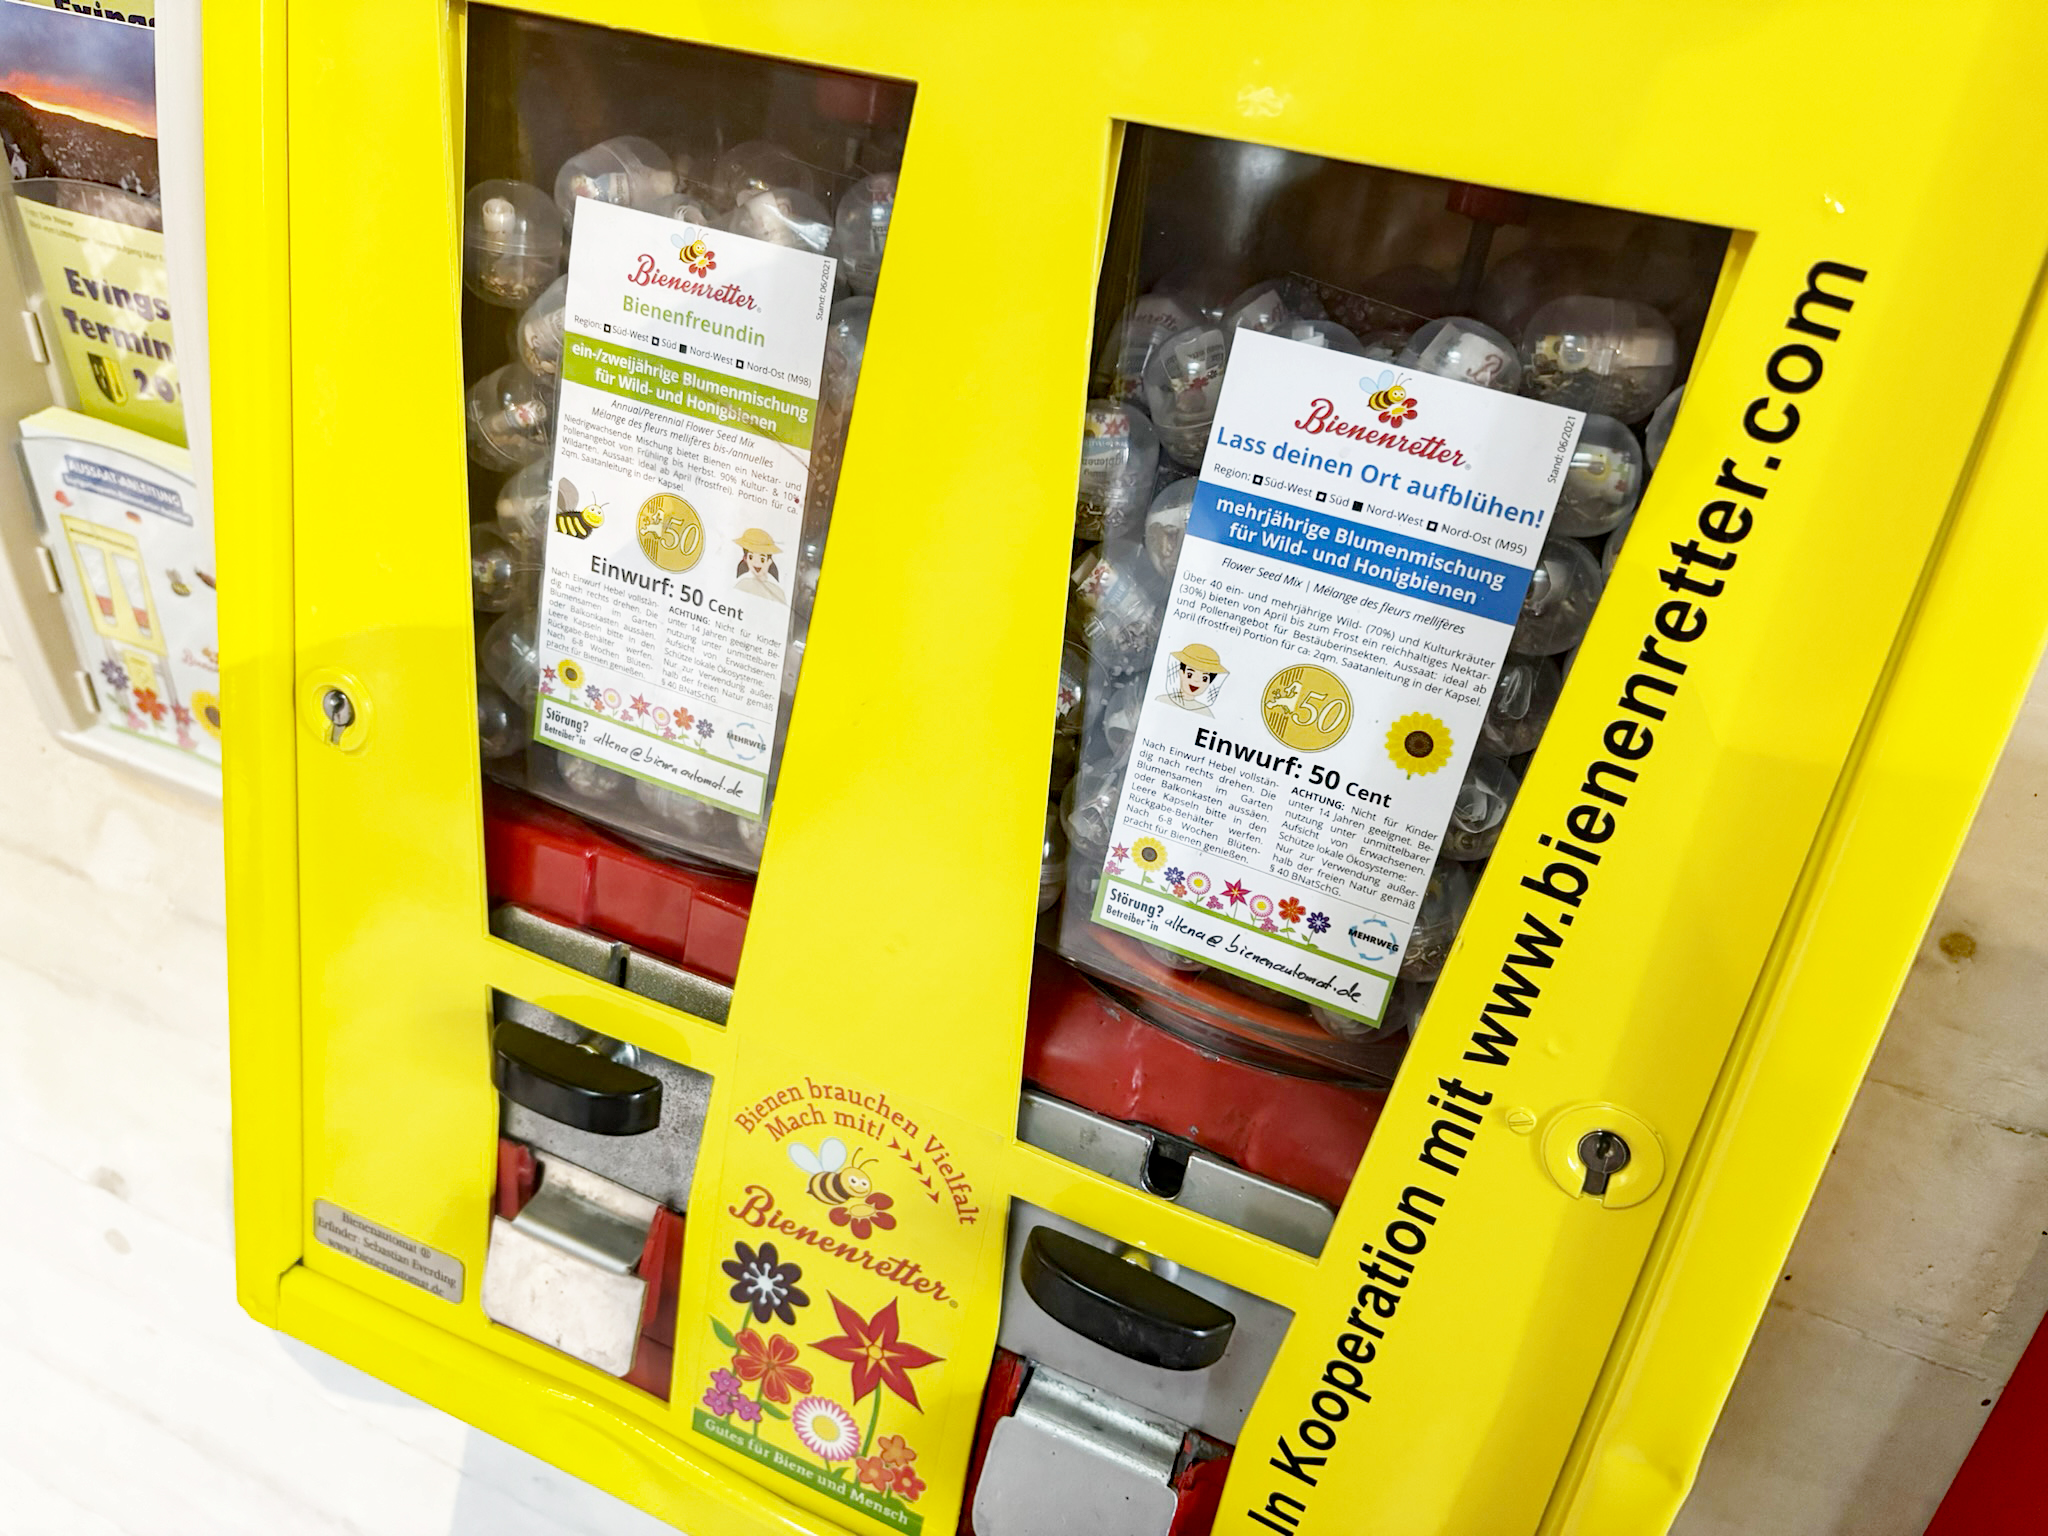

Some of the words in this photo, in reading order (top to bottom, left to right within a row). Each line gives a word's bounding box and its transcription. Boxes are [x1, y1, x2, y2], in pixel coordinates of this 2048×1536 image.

[627, 253, 757, 311] Bienenretter
[815, 294, 827, 321] Stand:
[821, 259, 832, 293] 06/2021
[574, 314, 602, 331] Region:
[611, 323, 650, 344] Süd-West
[661, 338, 678, 350] Süd
[689, 345, 734, 366] Nord-West
[746, 361, 785, 380] Nord-Ost
[787, 373, 812, 389] (M98)
[623, 294, 765, 348] Bienenfreundin
[572, 342, 679, 385] ein-/zweijährige
[682, 371, 809, 424] Blumenmischung
[595, 367, 616, 385] für
[618, 374, 654, 396] Wild-
[656, 387, 684, 405] und
[686, 393, 777, 432] Honigbienen
[591, 406, 626, 426] Mélange
[627, 417, 643, 430] des
[642, 421, 668, 437] fleurs
[669, 431, 711, 450] mellifères
[712, 442, 774, 469] bis-/annuelles
[610, 399, 685, 428] Annual/Perennial
[685, 420, 715, 436] Flower
[716, 429, 738, 443] Seed
[738, 436, 755, 449] Mix
[1294, 398, 1468, 467] Bienenretter
[1547, 451, 1564, 485] Stand:
[1557, 415, 1577, 453] 06/2021
[1213, 462, 1251, 482] Region:
[1263, 476, 1313, 498] Süd-West
[1328, 493, 1351, 508] Süd
[1366, 503, 1424, 528] Nord-West
[1440, 523, 1492, 546] Nord-Ost
[1494, 538, 1528, 557] (M95)
[1216, 426, 1267, 456] Lass
[1272, 441, 1353, 479] deinen
[1360, 464, 1402, 491] Ort
[1406, 479, 1545, 529] aufblühen!
[660, 518, 700, 557] 50
[1216, 498, 1331, 541] mehrjährige
[1334, 527, 1507, 592] Blumenmischung
[1228, 521, 1259, 543] für
[1261, 530, 1309, 557] Wild-
[1312, 548, 1351, 569] und
[1353, 556, 1477, 605] Honigbienen
[590, 554, 675, 599] Einwurf:
[679, 583, 704, 607] 50
[708, 598, 744, 621] Cent
[1182, 571, 1207, 585] Über
[1209, 579, 1223, 591] 40
[1225, 584, 1245, 596] ein-
[1247, 591, 1269, 604] und
[1270, 598, 1333, 623] mehrjährige
[1336, 615, 1362, 630] Wild-
[1365, 623, 1396, 642] (70%)
[1398, 635, 1421, 648] und
[1423, 640, 1497, 669] Kulturkräuter
[1221, 557, 1257, 575] Flower
[1256, 567, 1284, 583] Seed
[1282, 574, 1304, 588] Mix
[1312, 582, 1359, 605] Mélange
[1359, 596, 1379, 610] des
[1377, 601, 1412, 620] fleurs
[1412, 613, 1466, 635] mellifères
[1172, 608, 1197, 622] April
[1196, 614, 1245, 637] (frostfrei)
[1242, 627, 1279, 647] Portion
[1280, 638, 1296, 651] für
[1312, 648, 1338, 665] 2qm.
[1340, 657, 1411, 688] Saatanleitung
[1411, 678, 1423, 689] in
[1424, 682, 1444, 695] der
[1444, 687, 1481, 707] Kapsel.
[1176, 597, 1197, 609] und
[1199, 602, 1270, 631] Pollenangebot
[1273, 623, 1289, 636] für
[1292, 629, 1388, 666] Bestäuberinsekten.
[1392, 659, 1438, 680] Aussaat:
[1442, 673, 1469, 689] ideal
[1472, 683, 1487, 695] ab
[1179, 583, 1207, 601] (30%)
[1208, 591, 1240, 609] bieten
[1242, 603, 1261, 615] von
[1262, 608, 1289, 623] April
[1289, 614, 1305, 628] bis
[1307, 622, 1330, 635] zum
[1332, 627, 1360, 644] Frost
[1361, 637, 1378, 649] ein
[1380, 643, 1449, 669] reichhaltiges
[1450, 662, 1491, 681] Nektar-
[1462, 258, 1870, 1068] www.bienenretter.com
[546, 707, 589, 733] Störung?
[726, 731, 767, 751] MEHRWEG
[1292, 691, 1348, 734] 50
[1136, 759, 1203, 788] Blumensamen
[1215, 785, 1228, 797] im
[1240, 794, 1274, 812] Garten
[1139, 749, 1154, 763] dig
[1157, 756, 1181, 769] nach
[1184, 765, 1214, 780] rechts
[1218, 774, 1255, 794] drehen.
[1260, 787, 1277, 801] Die
[1142, 737, 1166, 752] Nach
[1169, 746, 1206, 765] Einwurf
[1207, 758, 1237, 775] Hebel
[1239, 770, 1279, 788] vollstän-
[1194, 727, 1303, 779] Einwurf:
[1308, 764, 1341, 791] 50
[1345, 781, 1393, 809] Cent
[1133, 772, 1156, 784] oder
[1160, 779, 1223, 807] Balkonkasten
[1227, 803, 1270, 823] aussäen.
[1290, 786, 1346, 811] ACHTUNG:
[1350, 805, 1377, 822] Nicht
[1383, 816, 1399, 828] für
[1404, 823, 1439, 841] Kinder
[1284, 810, 1324, 831] nutzung
[1329, 825, 1358, 840] unter
[1362, 836, 1432, 864] unmittelbarer
[1109, 887, 1165, 919] Störung?
[1347, 928, 1400, 953] MEHRWEG
[734, 1084, 805, 1136] Bienen
[805, 1076, 919, 1140] brauchen
[923, 1133, 980, 1225] Vielfalt
[764, 1102, 827, 1143] Mach
[833, 1110, 886, 1142] mit!
[1417, 1076, 1494, 1177] mit
[318, 1216, 361, 1243] Erfinder:
[362, 1237, 410, 1266] Sebastian
[411, 1259, 457, 1290] Everding
[342, 1212, 418, 1254] Bienenautomat
[728, 1184, 950, 1303] Bienenretter
[1268, 1184, 1446, 1488] Kooperation
[704, 1416, 746, 1449] Gutes
[746, 1436, 771, 1459] für
[773, 1450, 815, 1481] Biene
[816, 1469, 847, 1495] und
[849, 1485, 910, 1527] Mensch
[1247, 1490, 1307, 1536] In
